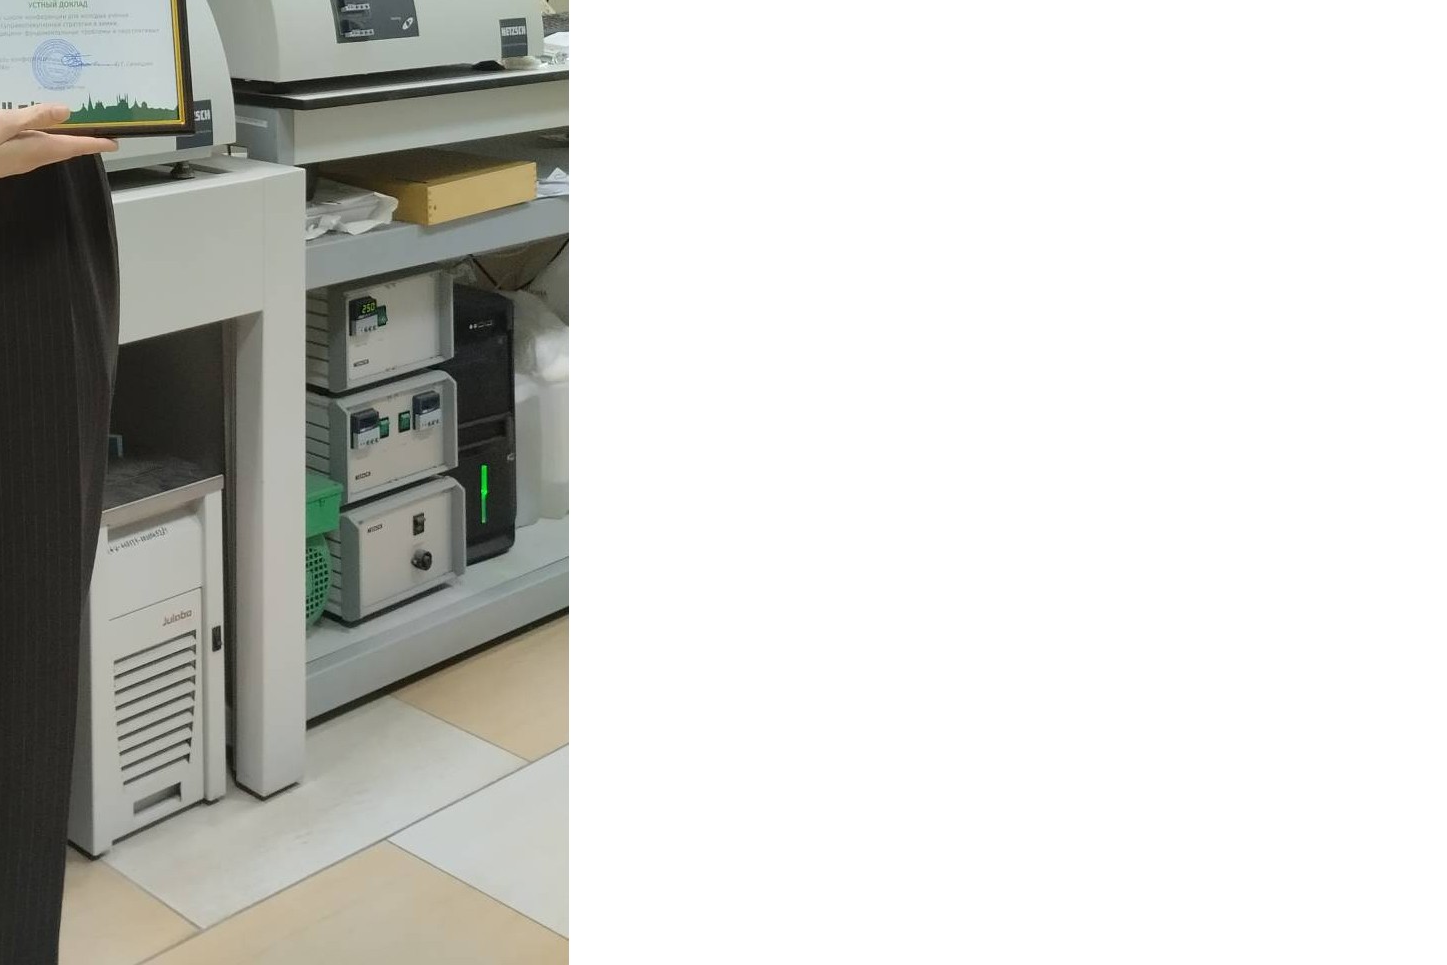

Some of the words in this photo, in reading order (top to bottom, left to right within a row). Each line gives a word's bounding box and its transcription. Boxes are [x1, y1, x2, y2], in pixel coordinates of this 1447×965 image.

[28, 0, 57, 9] УСТНЫЙ
[58, 0, 88, 10] ДОКЛАД
[500, 25, 526, 37] NETZSCH
[194, 109, 211, 121] SCH
